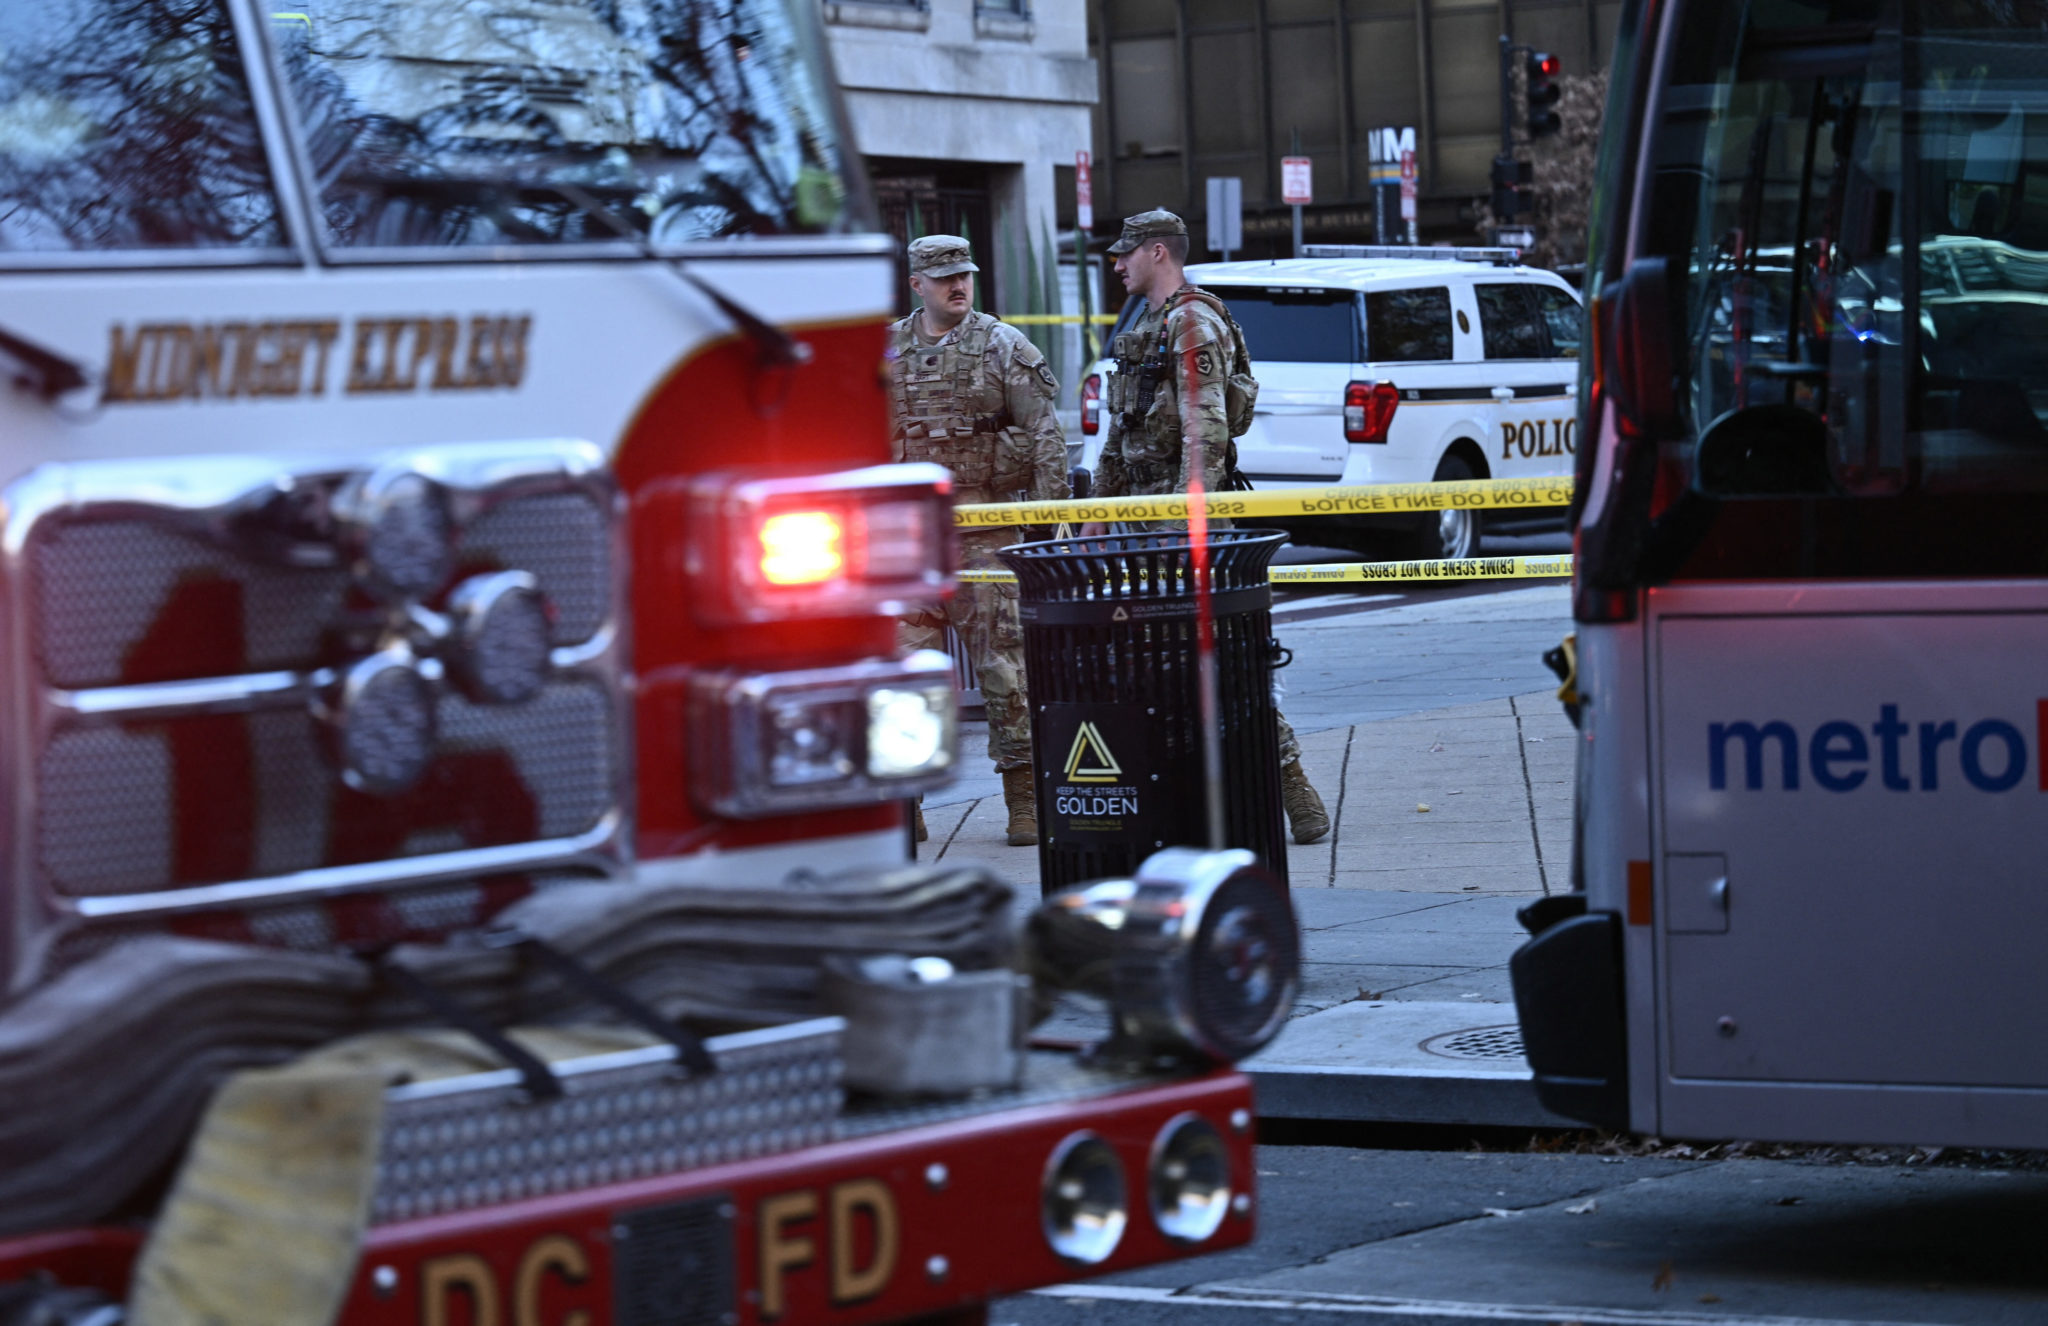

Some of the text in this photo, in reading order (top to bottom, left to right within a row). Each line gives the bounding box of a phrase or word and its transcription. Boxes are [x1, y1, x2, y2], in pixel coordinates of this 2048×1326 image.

[1382, 126, 1416, 162] M
[1500, 418, 1577, 459] POLIC
[1362, 558, 1515, 579] CRIME SCENE DO NOT CROSS
[1708, 697, 2048, 793] metro
[1056, 786, 1138, 797] KEEP THE STREETS
[1056, 796, 1138, 815] GOLDEN
[423, 1177, 897, 1326] DC FD
